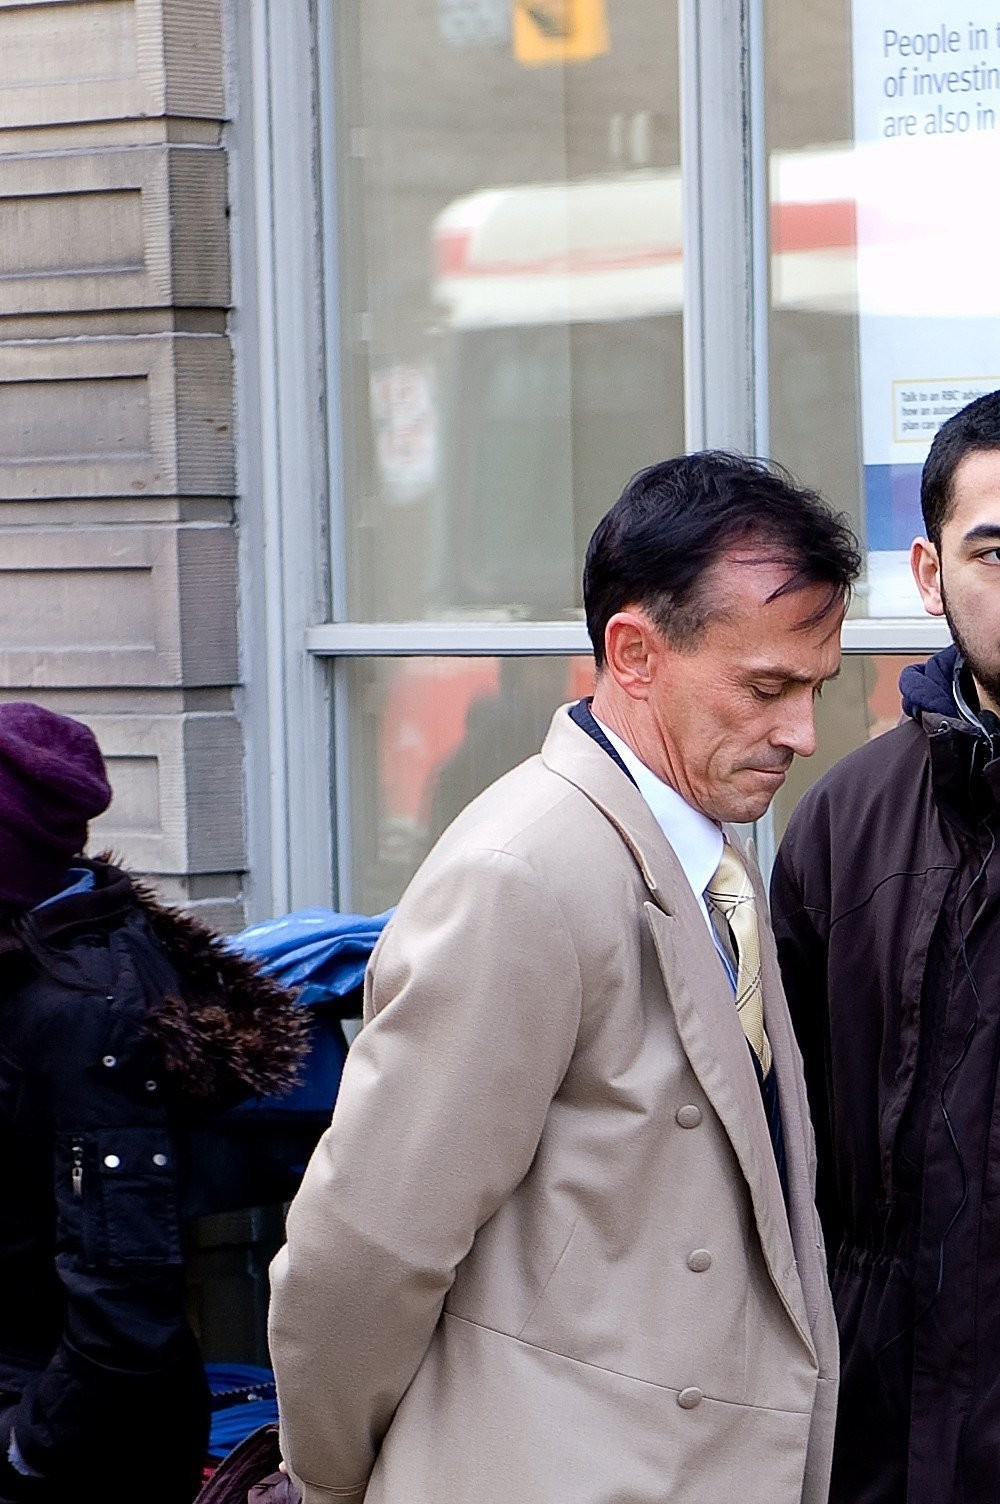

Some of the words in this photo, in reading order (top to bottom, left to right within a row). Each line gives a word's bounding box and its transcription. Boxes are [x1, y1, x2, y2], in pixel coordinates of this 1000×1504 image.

[883, 23, 961, 62] People
[968, 21, 989, 51] in
[883, 67, 908, 98] of
[883, 114, 918, 138] are
[924, 104, 970, 135] also
[976, 102, 995, 130] in
